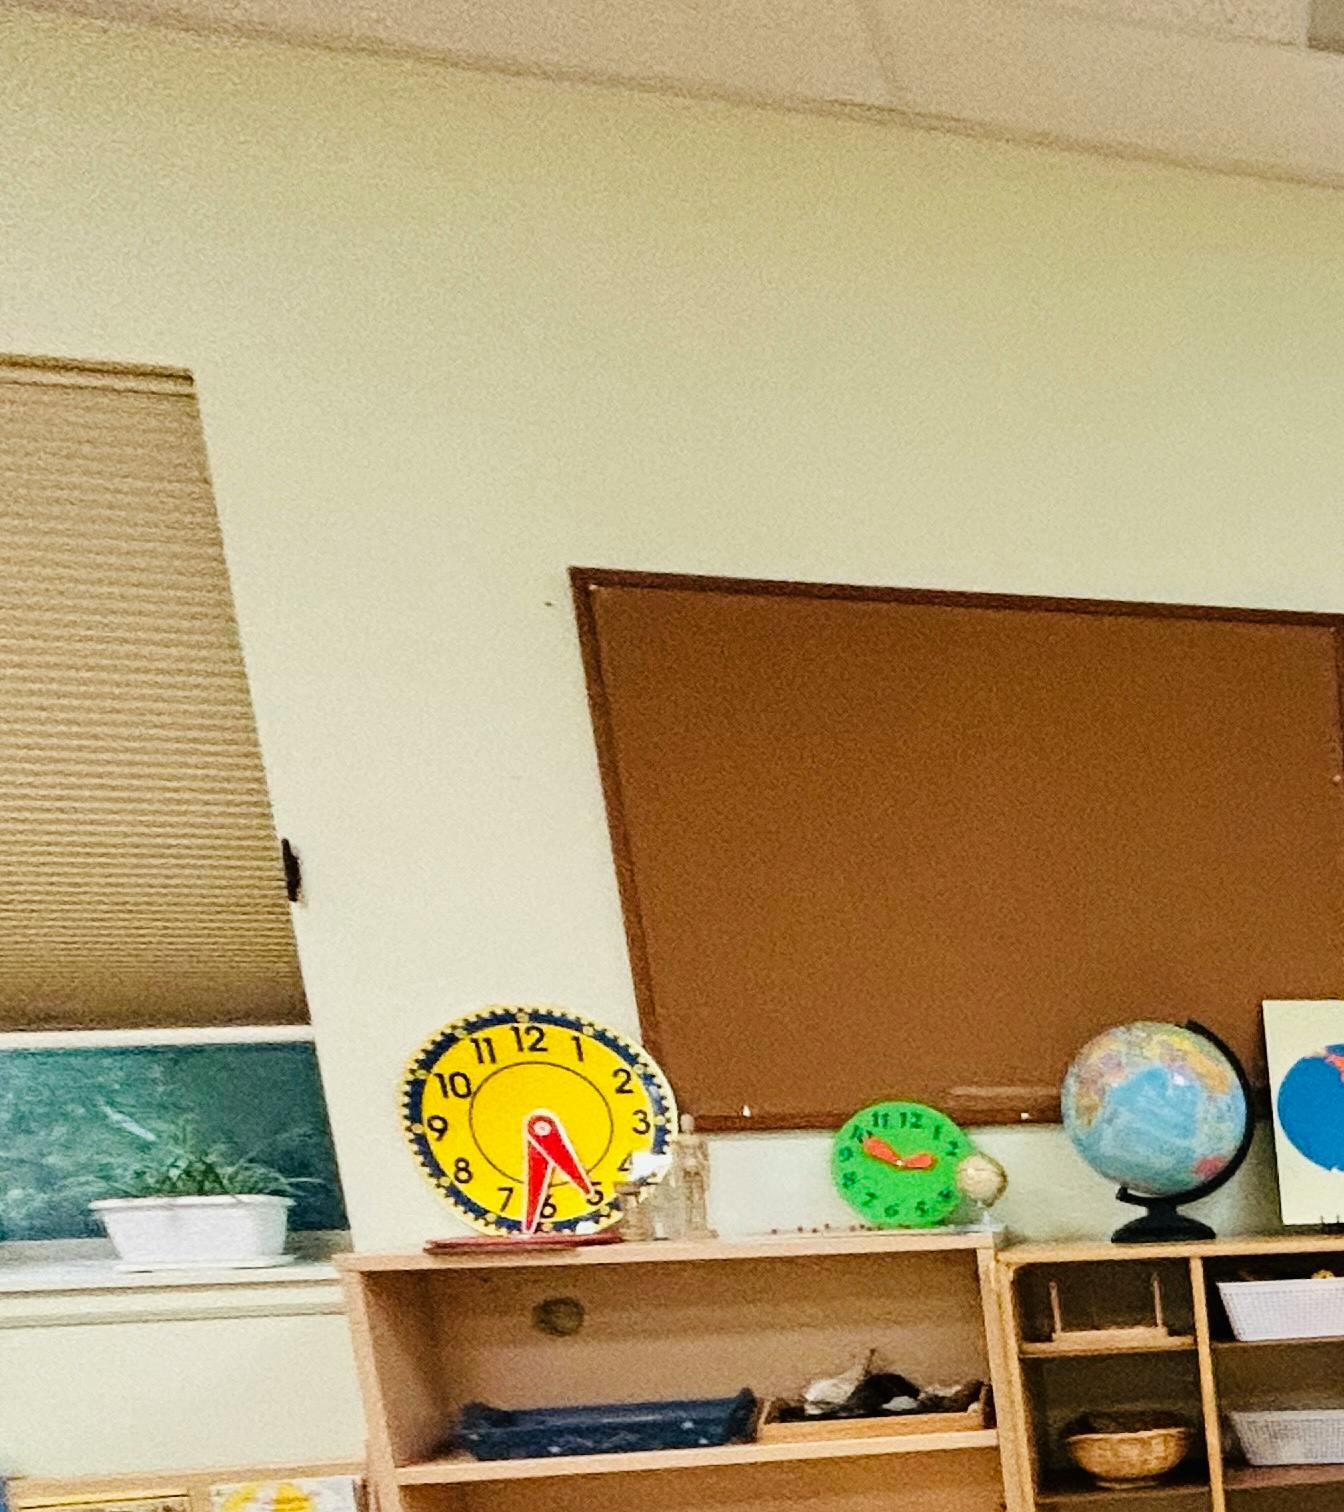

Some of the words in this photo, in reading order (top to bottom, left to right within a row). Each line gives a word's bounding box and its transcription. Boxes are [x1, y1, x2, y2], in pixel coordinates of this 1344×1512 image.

[470, 1037, 497, 1064] 11
[510, 1025, 548, 1053] 12
[571, 1035, 584, 1062] 1
[434, 1071, 473, 1099] 10
[612, 1068, 634, 1095] 2
[426, 1114, 449, 1142] 9
[631, 1109, 651, 1135] 3
[871, 1111, 890, 1128] 11
[900, 1111, 923, 1129] 12
[932, 1124, 942, 1140] 1
[838, 1146, 854, 1163] 9
[946, 1140, 959, 1157] 2
[453, 1157, 473, 1184] 8
[842, 1171, 858, 1189] 8
[497, 1186, 515, 1213] 7
[539, 1193, 558, 1219] 6
[884, 1203, 899, 1218] 6
